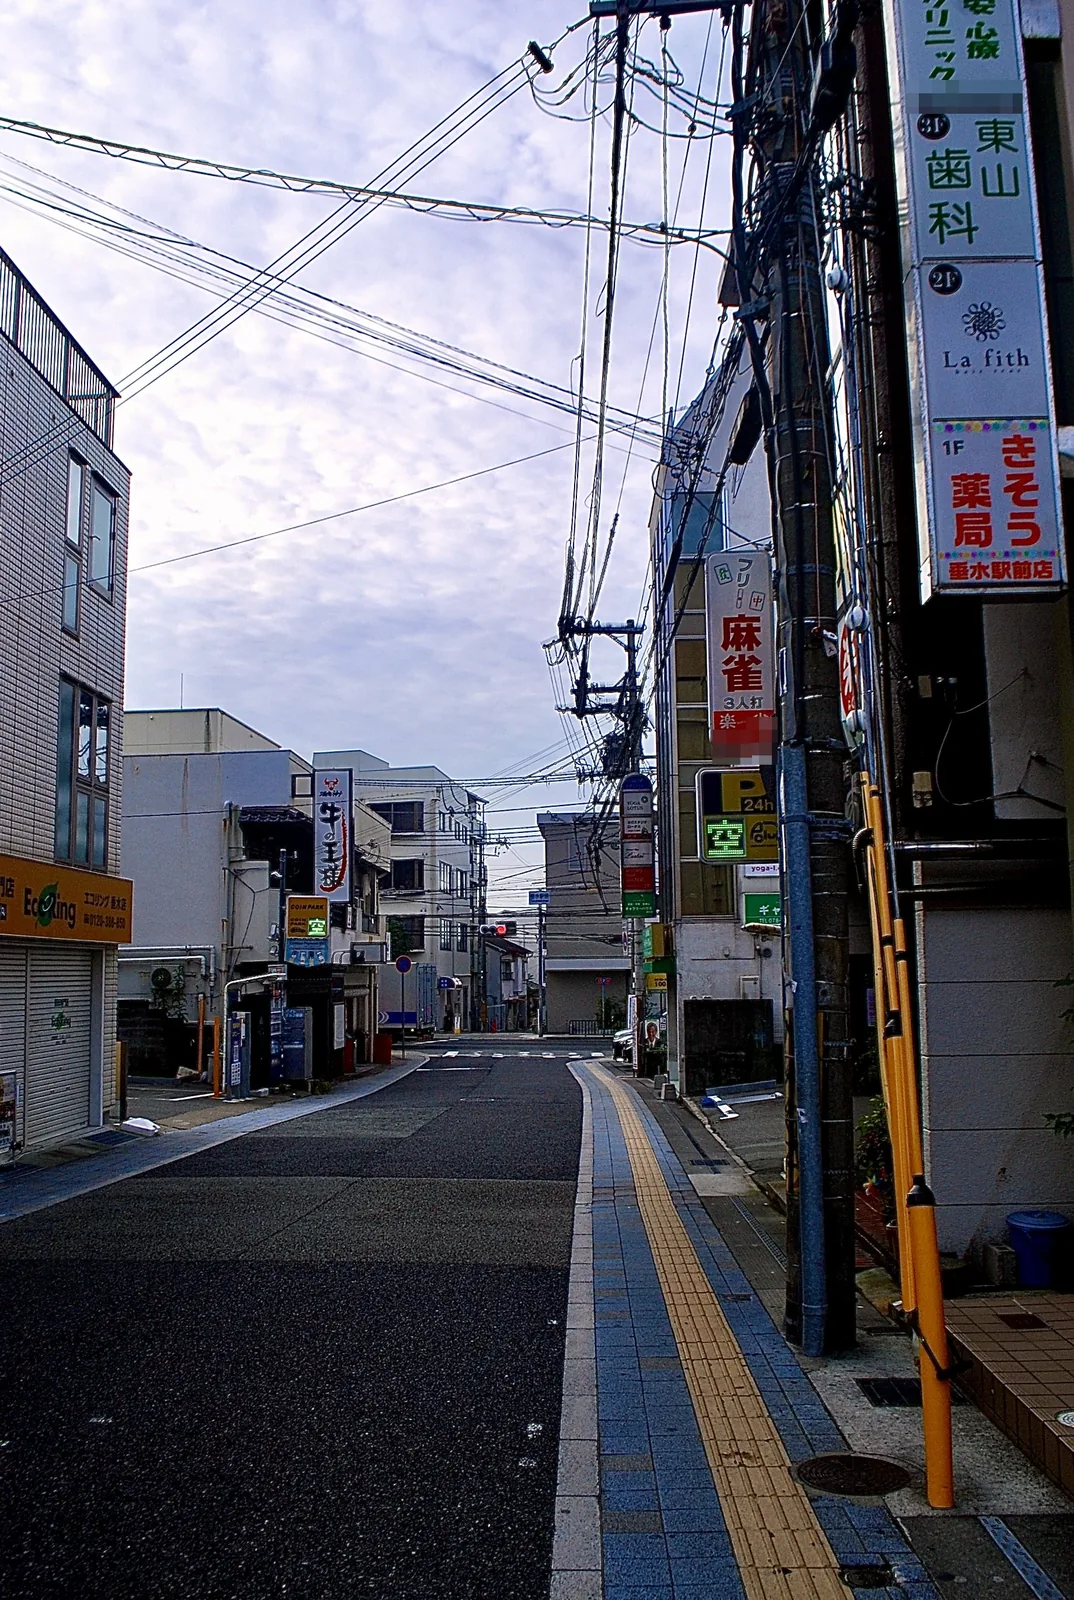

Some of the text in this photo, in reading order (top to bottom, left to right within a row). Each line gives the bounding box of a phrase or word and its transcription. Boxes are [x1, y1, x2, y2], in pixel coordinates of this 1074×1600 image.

[975, 118, 1020, 197] 東山
[924, 148, 980, 245] 歯科
[932, 271, 959, 289] 2F
[943, 347, 1030, 368] La fith
[942, 440, 964, 456] 1F
[1002, 434, 1042, 547] きそう
[951, 472, 993, 548] 薬局
[948, 560, 1053, 581] 垂水駅前店
[720, 613, 763, 693] 麻雀
[723, 696, 764, 710] 3人打
[743, 799, 774, 812] 24h
[707, 819, 744, 856] 空
[308, 918, 326, 936] 空
